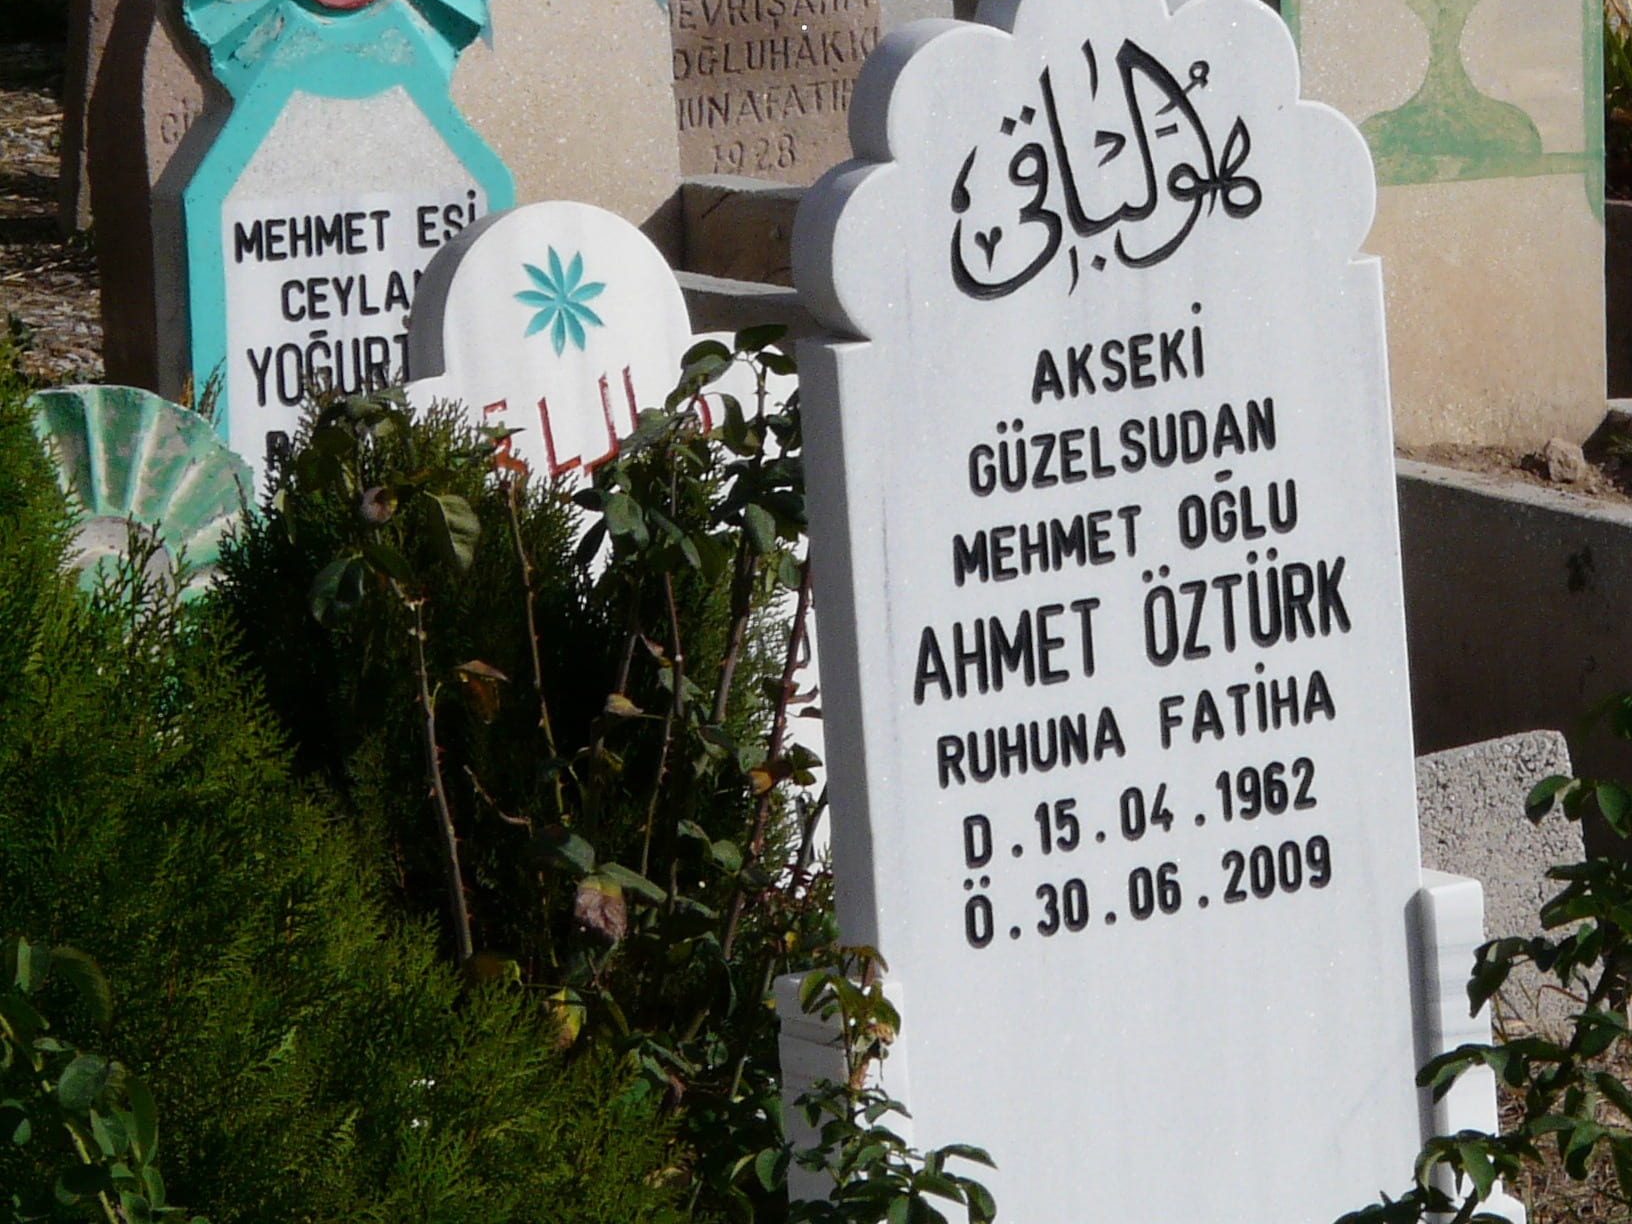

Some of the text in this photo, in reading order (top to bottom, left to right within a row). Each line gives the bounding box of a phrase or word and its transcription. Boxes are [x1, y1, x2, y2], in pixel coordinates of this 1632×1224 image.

[234, 210, 391, 263] MEHMET
[281, 269, 426, 322] CEYLA
[1031, 302, 1205, 405] AKSEKİ
[967, 397, 1278, 497] GÜZELSUDAN
[953, 469, 1298, 587] MEHMET OĞLU
[913, 548, 1351, 704] AHMET ÖZTÜRK
[938, 661, 1336, 789] RUHUNA FATİHA
